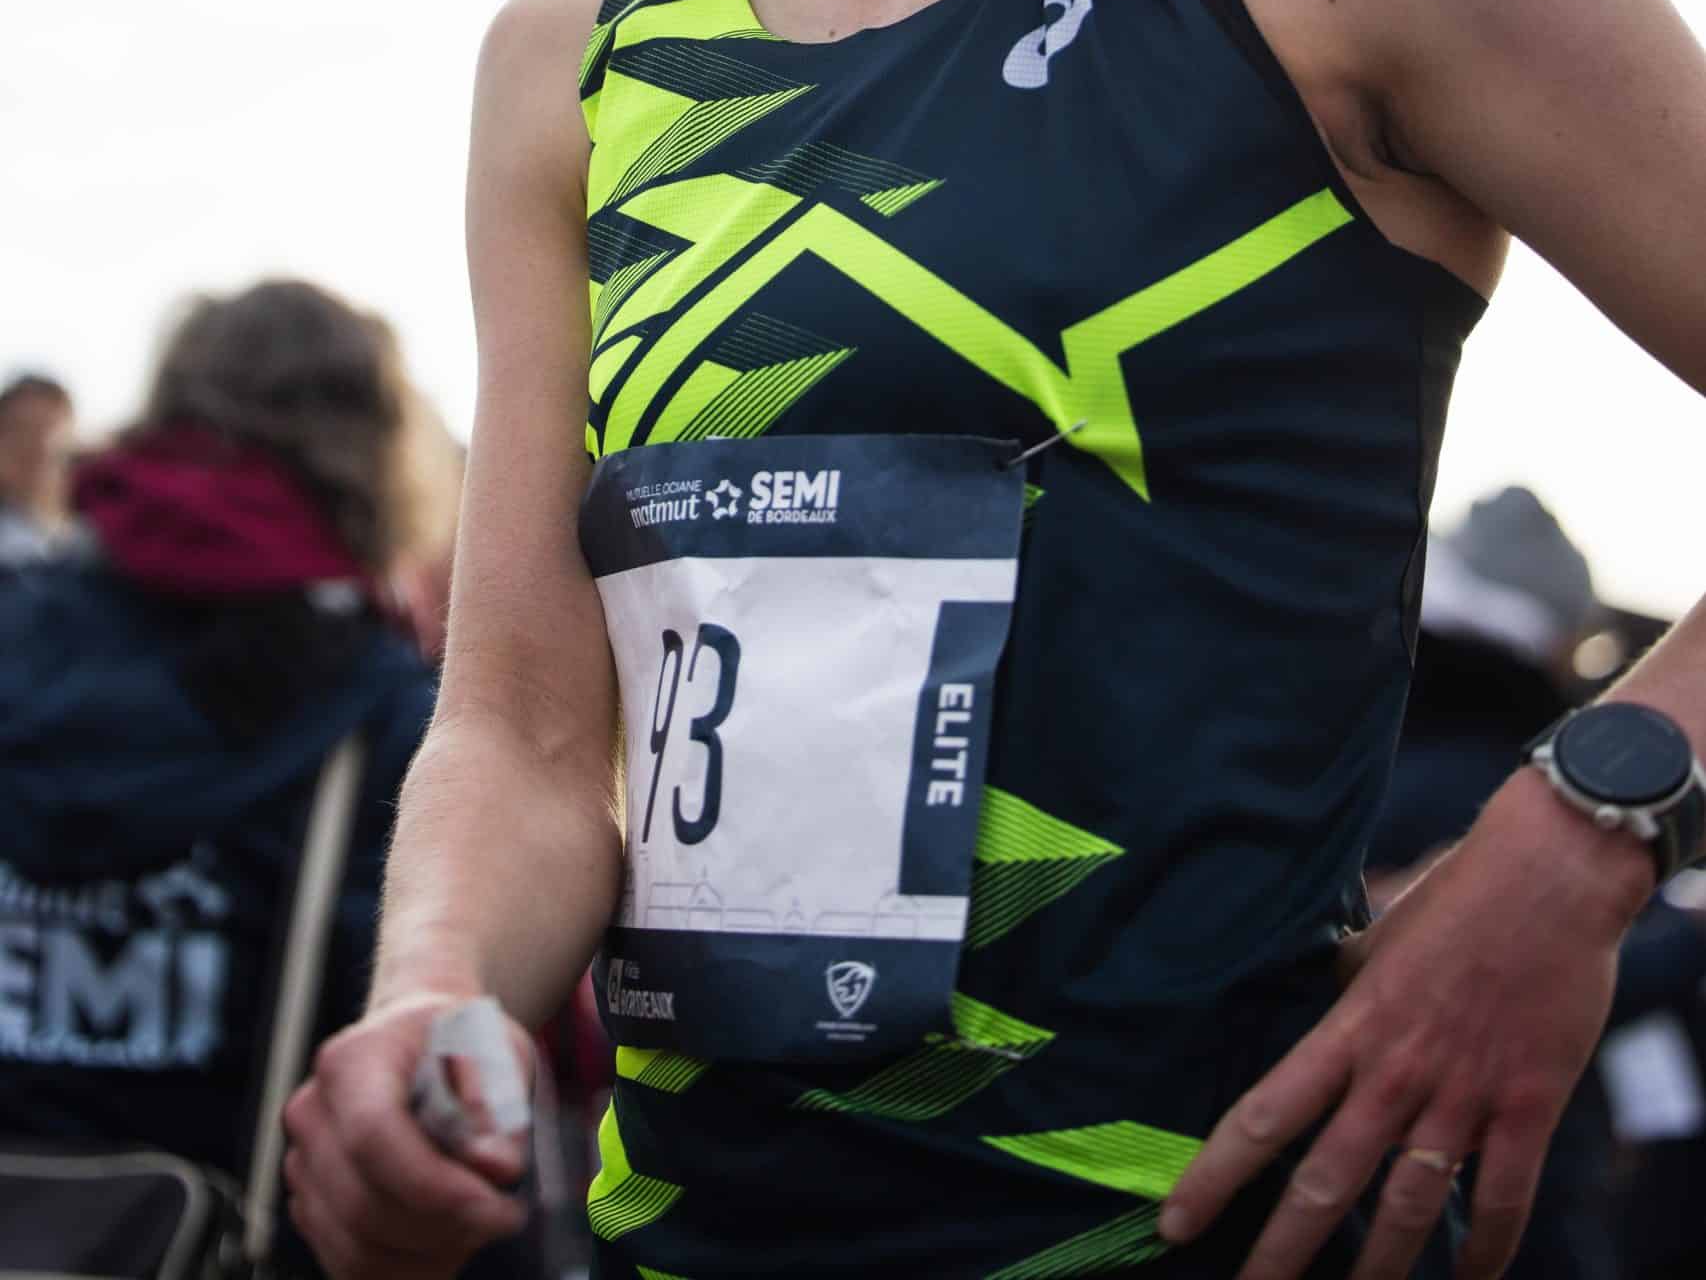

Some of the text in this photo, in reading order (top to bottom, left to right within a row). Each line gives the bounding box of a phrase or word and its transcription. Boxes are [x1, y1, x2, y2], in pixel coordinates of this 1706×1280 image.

[662, 480, 703, 495] OCIANE
[749, 470, 841, 510] SEMI
[630, 493, 701, 529] matmut
[747, 509, 837, 524] DE BORDEAUX
[642, 623, 741, 845] 93
[926, 683, 974, 807] ELITE
